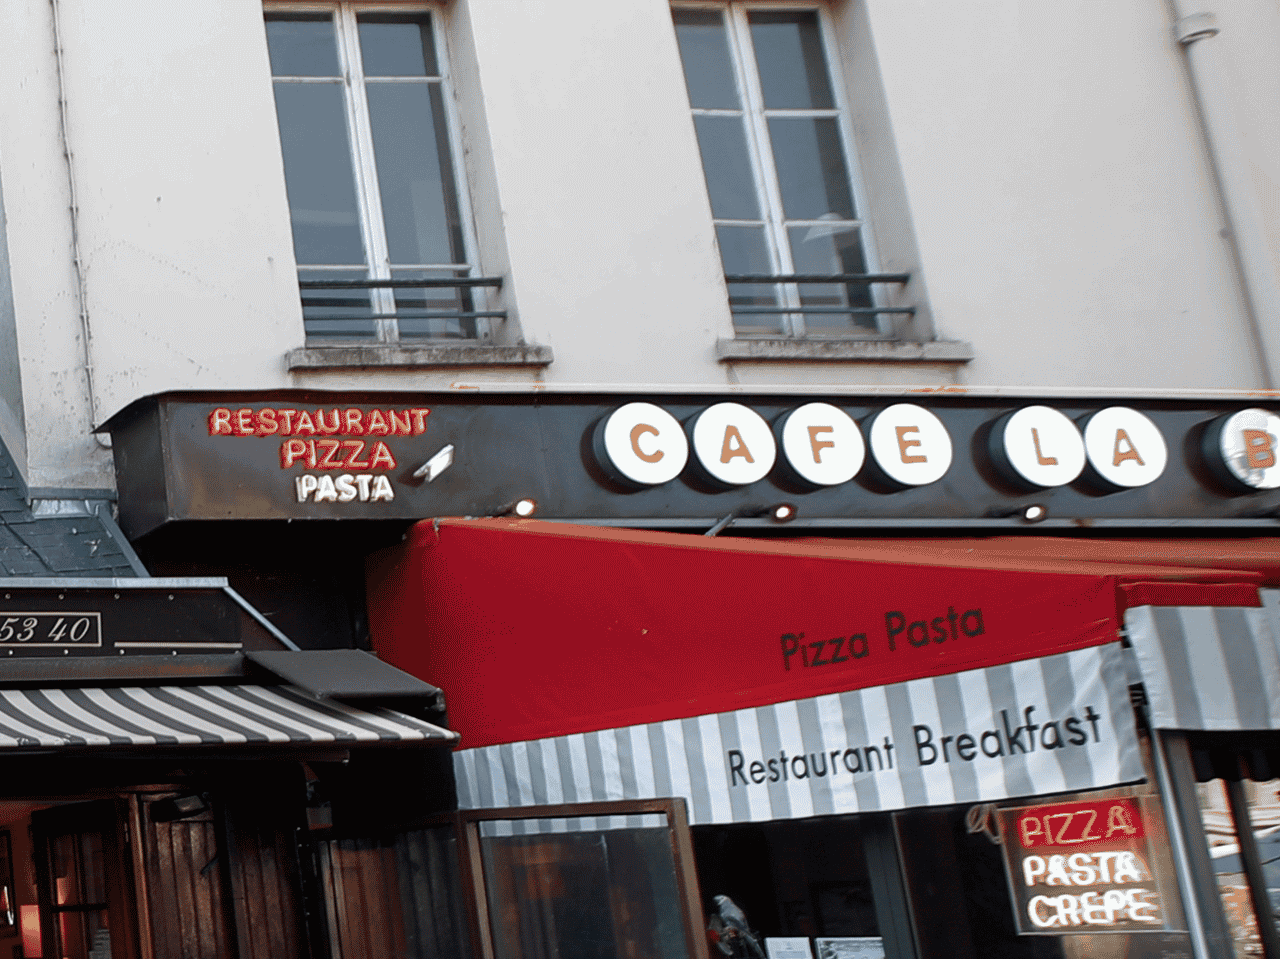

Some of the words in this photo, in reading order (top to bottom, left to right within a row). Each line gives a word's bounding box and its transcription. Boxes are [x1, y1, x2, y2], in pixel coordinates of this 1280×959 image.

[208, 407, 431, 437] RESTAURANT
[279, 439, 397, 470] PIZZA
[629, 422, 928, 465] CAFE
[1031, 427, 1146, 467] LA
[296, 474, 395, 502] PASTA
[48, 617, 90, 641] 40
[780, 632, 870, 671] Pizza
[884, 606, 985, 652] Pasta
[728, 736, 894, 786] Restaurant
[913, 705, 1102, 766] Breakfast
[1020, 805, 1137, 846] PIZZA
[1022, 851, 1142, 886] PASTA
[1028, 888, 1160, 927] CREPE
